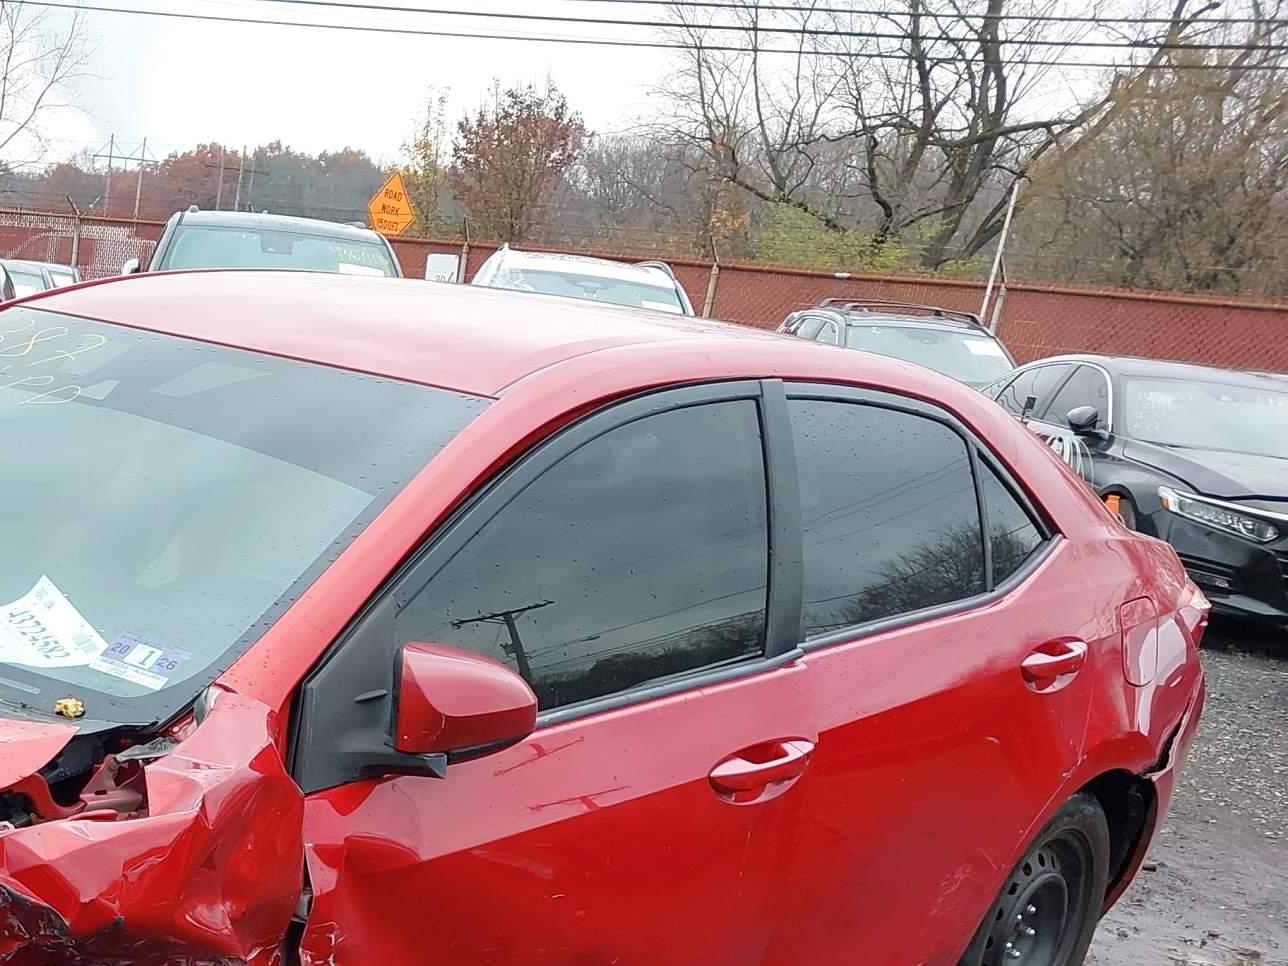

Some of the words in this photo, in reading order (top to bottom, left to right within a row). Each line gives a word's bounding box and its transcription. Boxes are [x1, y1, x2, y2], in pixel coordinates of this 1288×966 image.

[384, 188, 403, 202] ROAD
[381, 203, 400, 217] WORK
[111, 642, 131, 656] 20
[156, 657, 178, 671] 26
